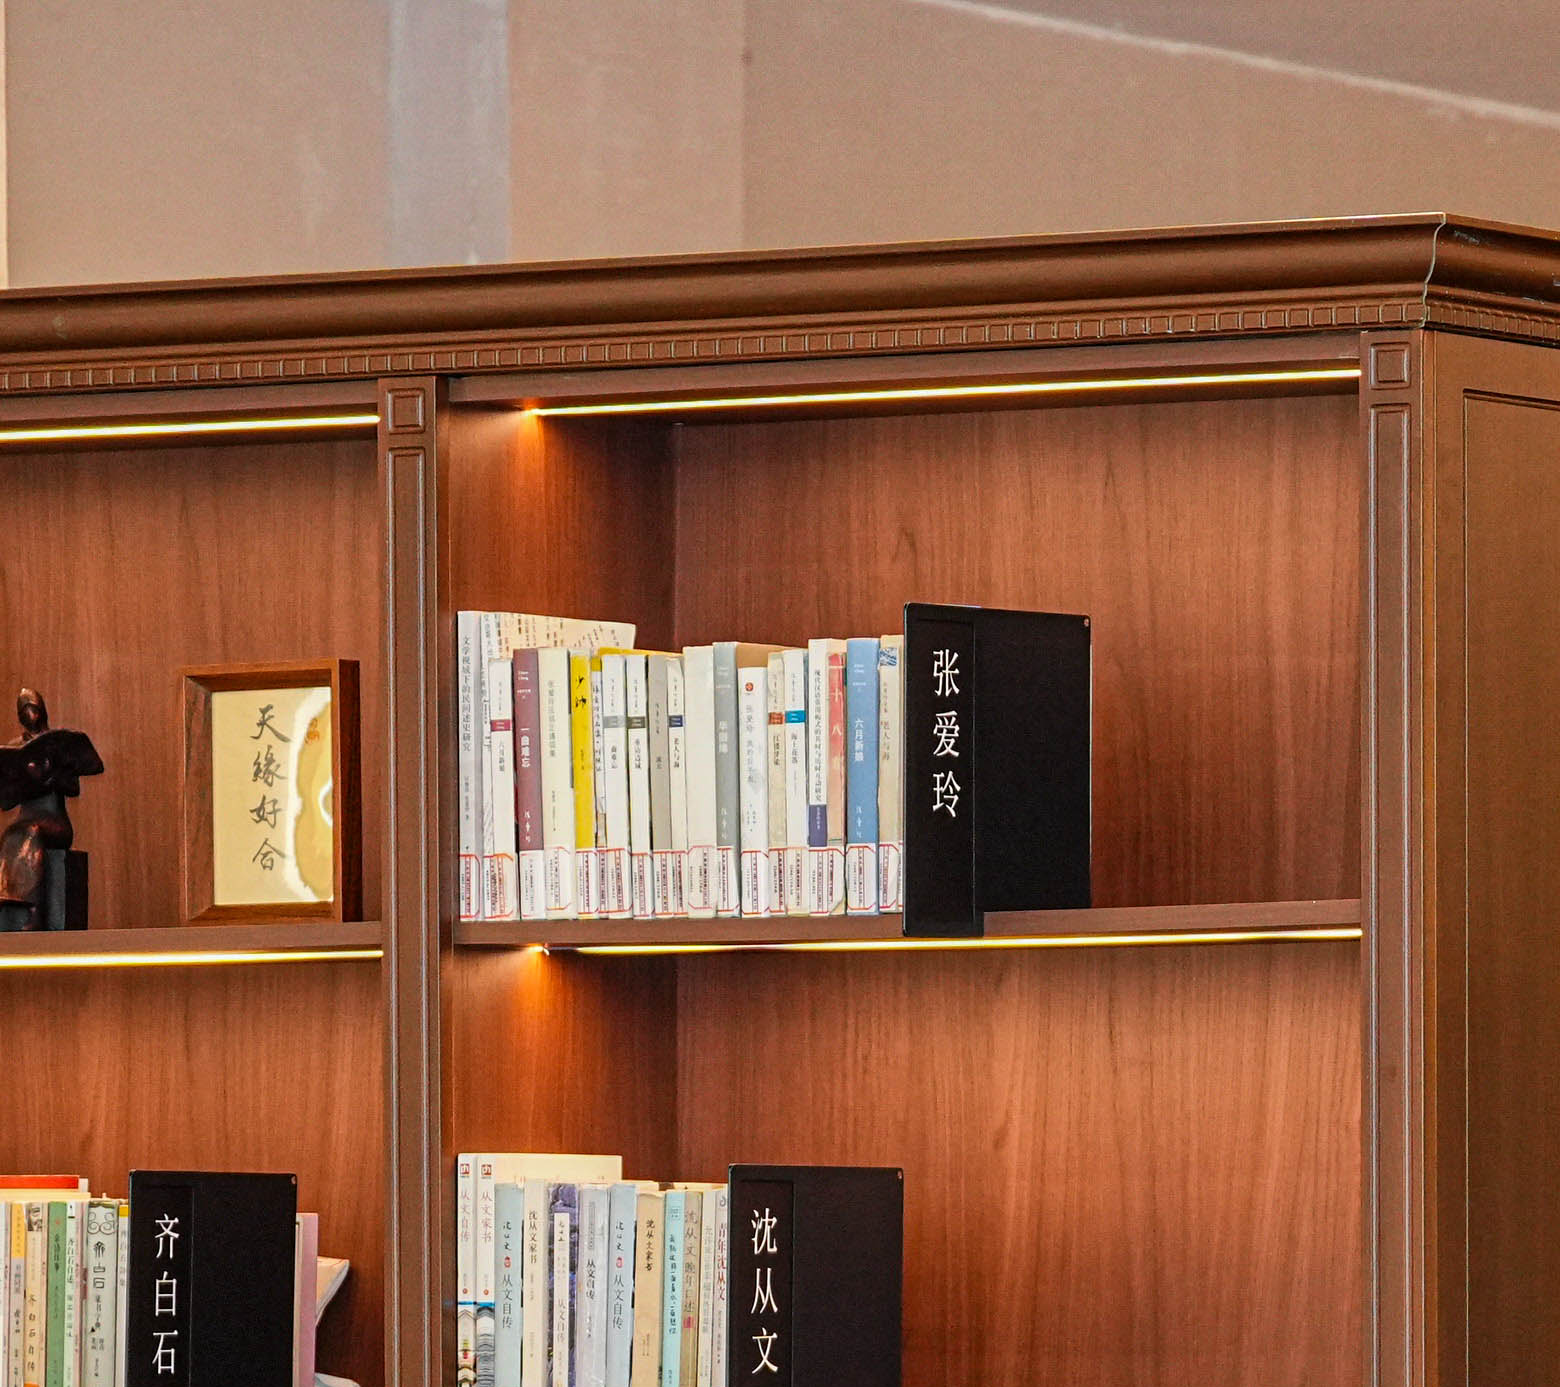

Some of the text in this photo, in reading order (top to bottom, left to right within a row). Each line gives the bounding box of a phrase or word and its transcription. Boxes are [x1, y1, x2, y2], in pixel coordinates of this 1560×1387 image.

[853, 717, 865, 763] 六月新娘
[930, 647, 963, 820] 张爱玲
[459, 1190, 471, 1243] 从文自传
[480, 1190, 493, 1244] 从文家书
[152, 1212, 181, 1376] 齐白石
[501, 1272, 514, 1330] 从文自传
[611, 1272, 625, 1330] 从文自传
[749, 1206, 780, 1376] 沈从文
